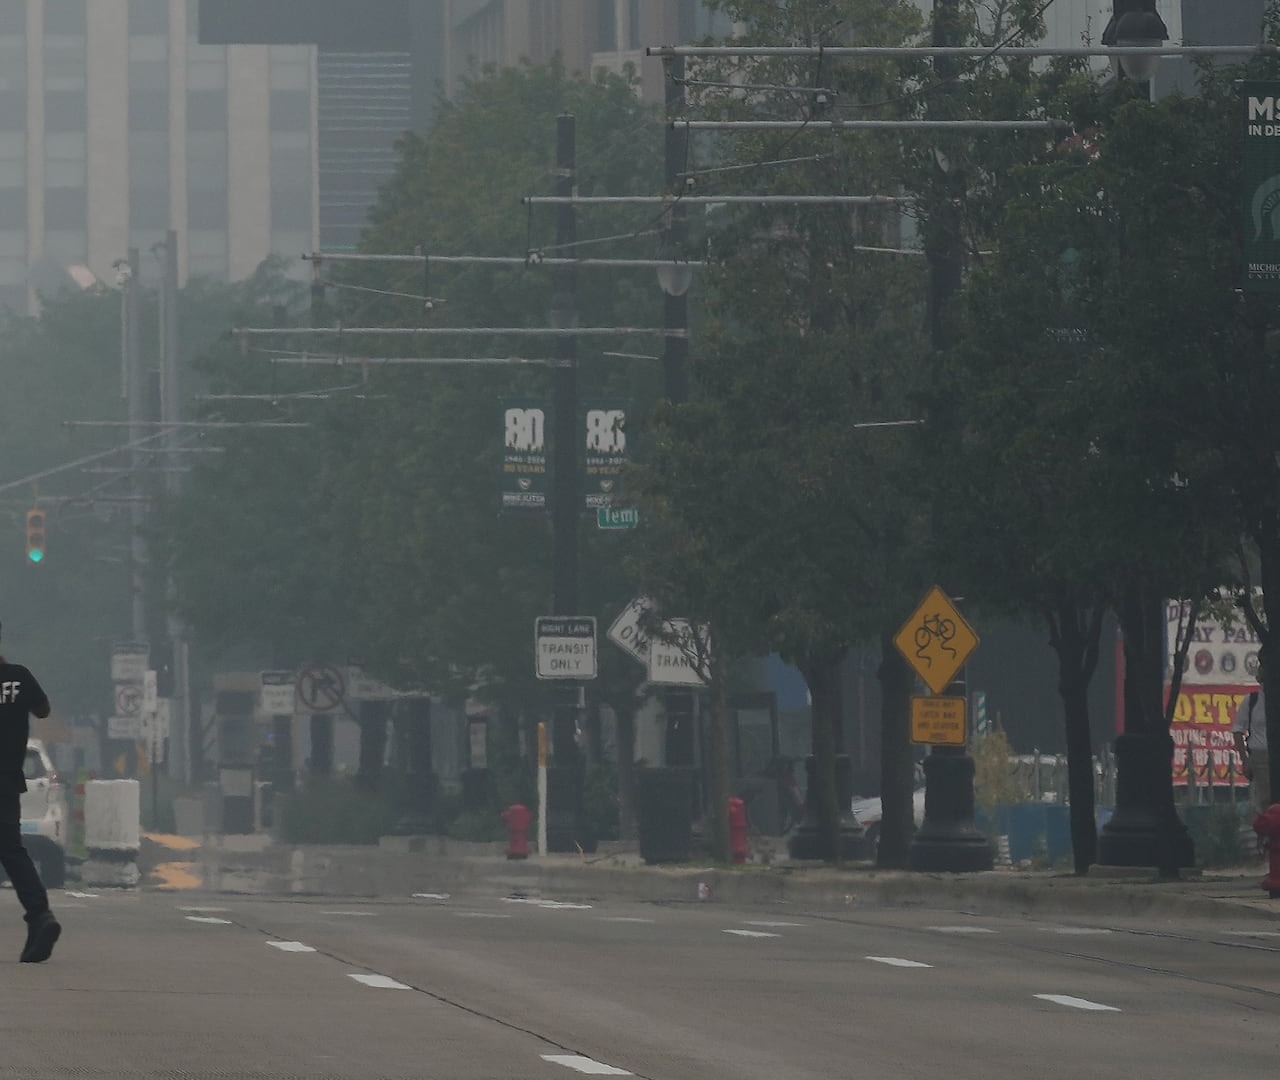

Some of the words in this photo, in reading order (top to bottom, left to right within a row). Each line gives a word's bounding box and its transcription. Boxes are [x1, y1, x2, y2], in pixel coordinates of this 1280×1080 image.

[1248, 125, 1262, 136] IN
[505, 408, 545, 452] 80
[542, 624, 564, 633] RIGHT
[568, 624, 590, 633] LANE
[542, 643, 590, 654] TRANSIT
[550, 659, 582, 670] ONLY
